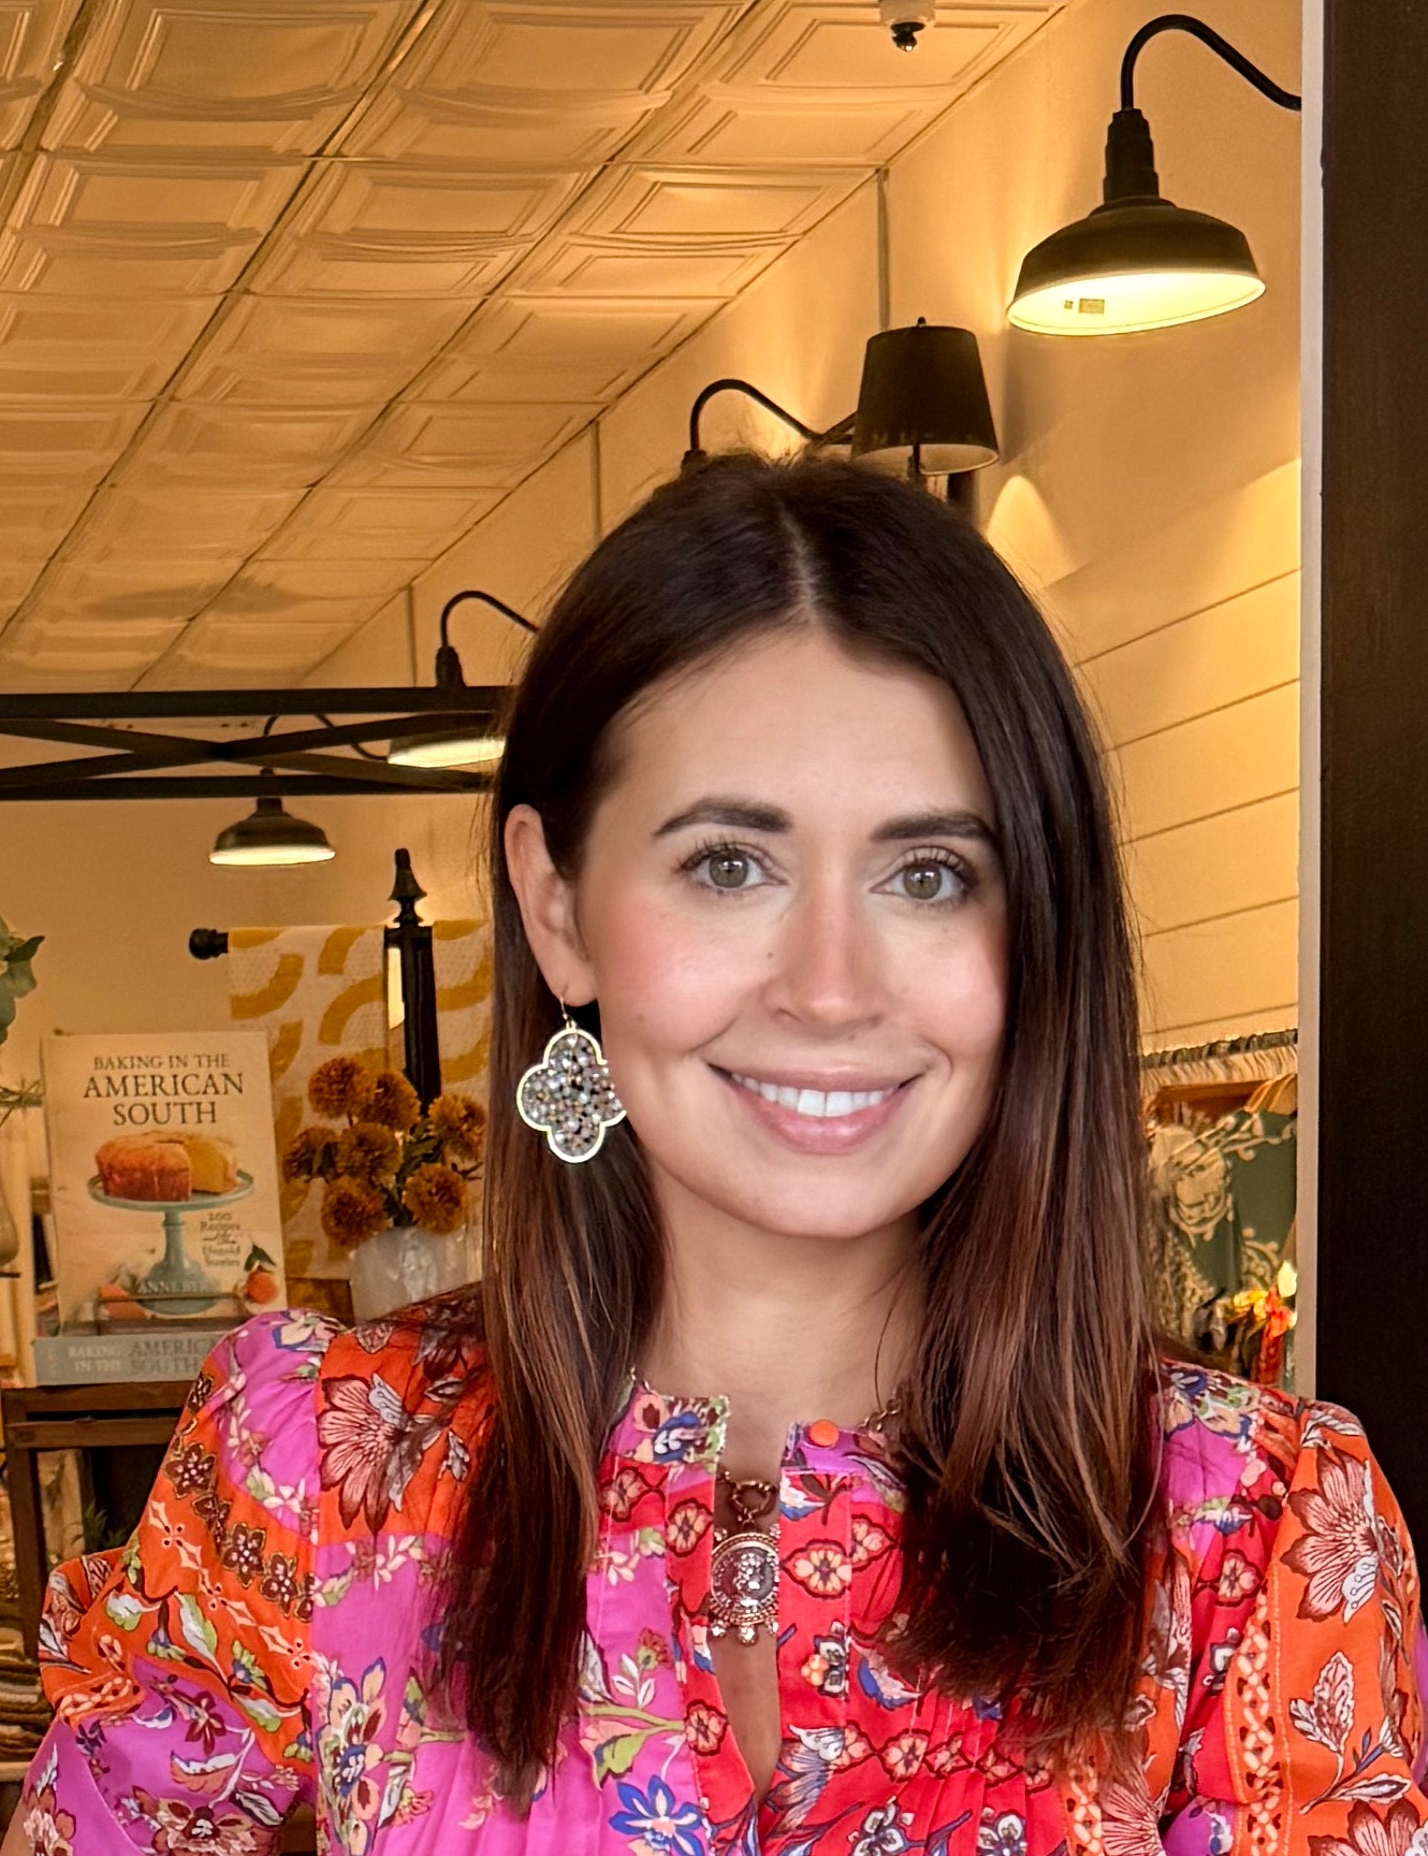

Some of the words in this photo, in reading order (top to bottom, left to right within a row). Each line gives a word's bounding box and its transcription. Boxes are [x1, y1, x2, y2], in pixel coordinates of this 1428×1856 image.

[93, 1055, 163, 1070] BAKING
[168, 1055, 188, 1069] IN
[193, 1053, 230, 1069] THE
[83, 1072, 243, 1098] AMERICAN
[113, 1101, 217, 1126] SOUTH
[129, 1338, 215, 1357] AMERIC
